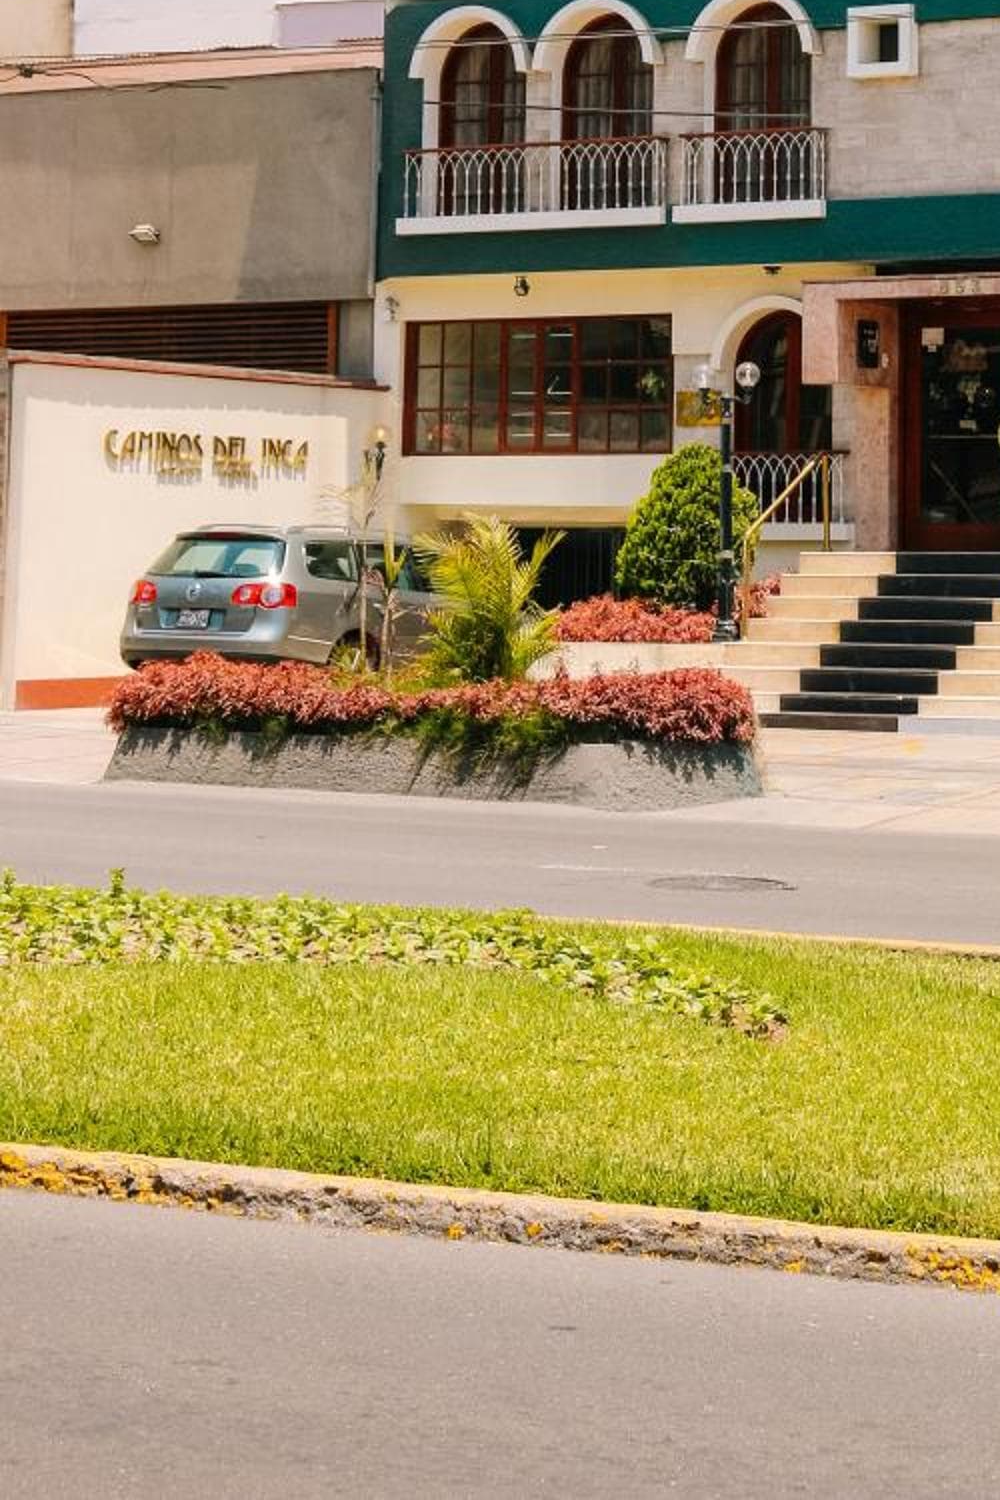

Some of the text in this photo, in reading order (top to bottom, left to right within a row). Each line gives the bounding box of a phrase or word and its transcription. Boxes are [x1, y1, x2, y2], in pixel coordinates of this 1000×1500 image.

[103, 428, 309, 467] CAMINOS DEL INCA
